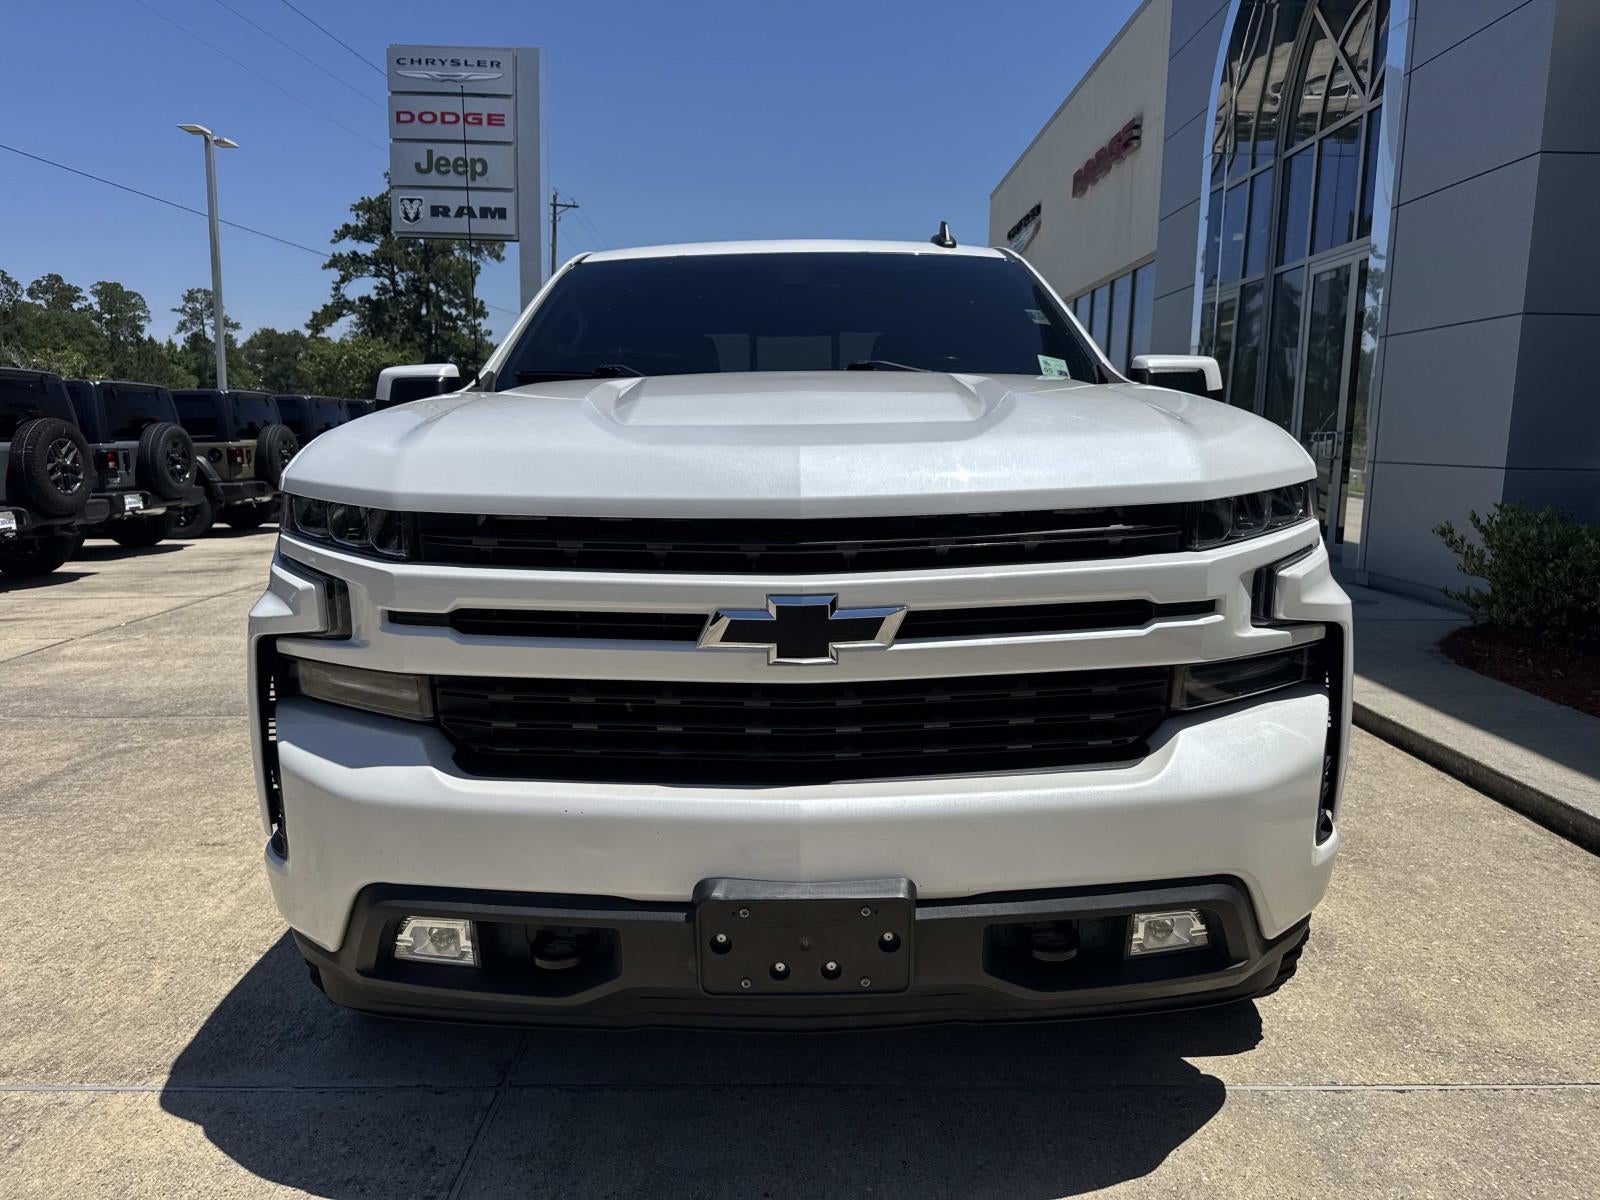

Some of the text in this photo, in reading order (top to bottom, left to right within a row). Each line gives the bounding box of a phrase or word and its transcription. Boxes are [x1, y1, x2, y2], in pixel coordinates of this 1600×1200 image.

[395, 57, 502, 69] CHRYSLER
[395, 110, 506, 127] DODGE
[414, 149, 488, 181] Jeep
[430, 205, 507, 220] RAM
